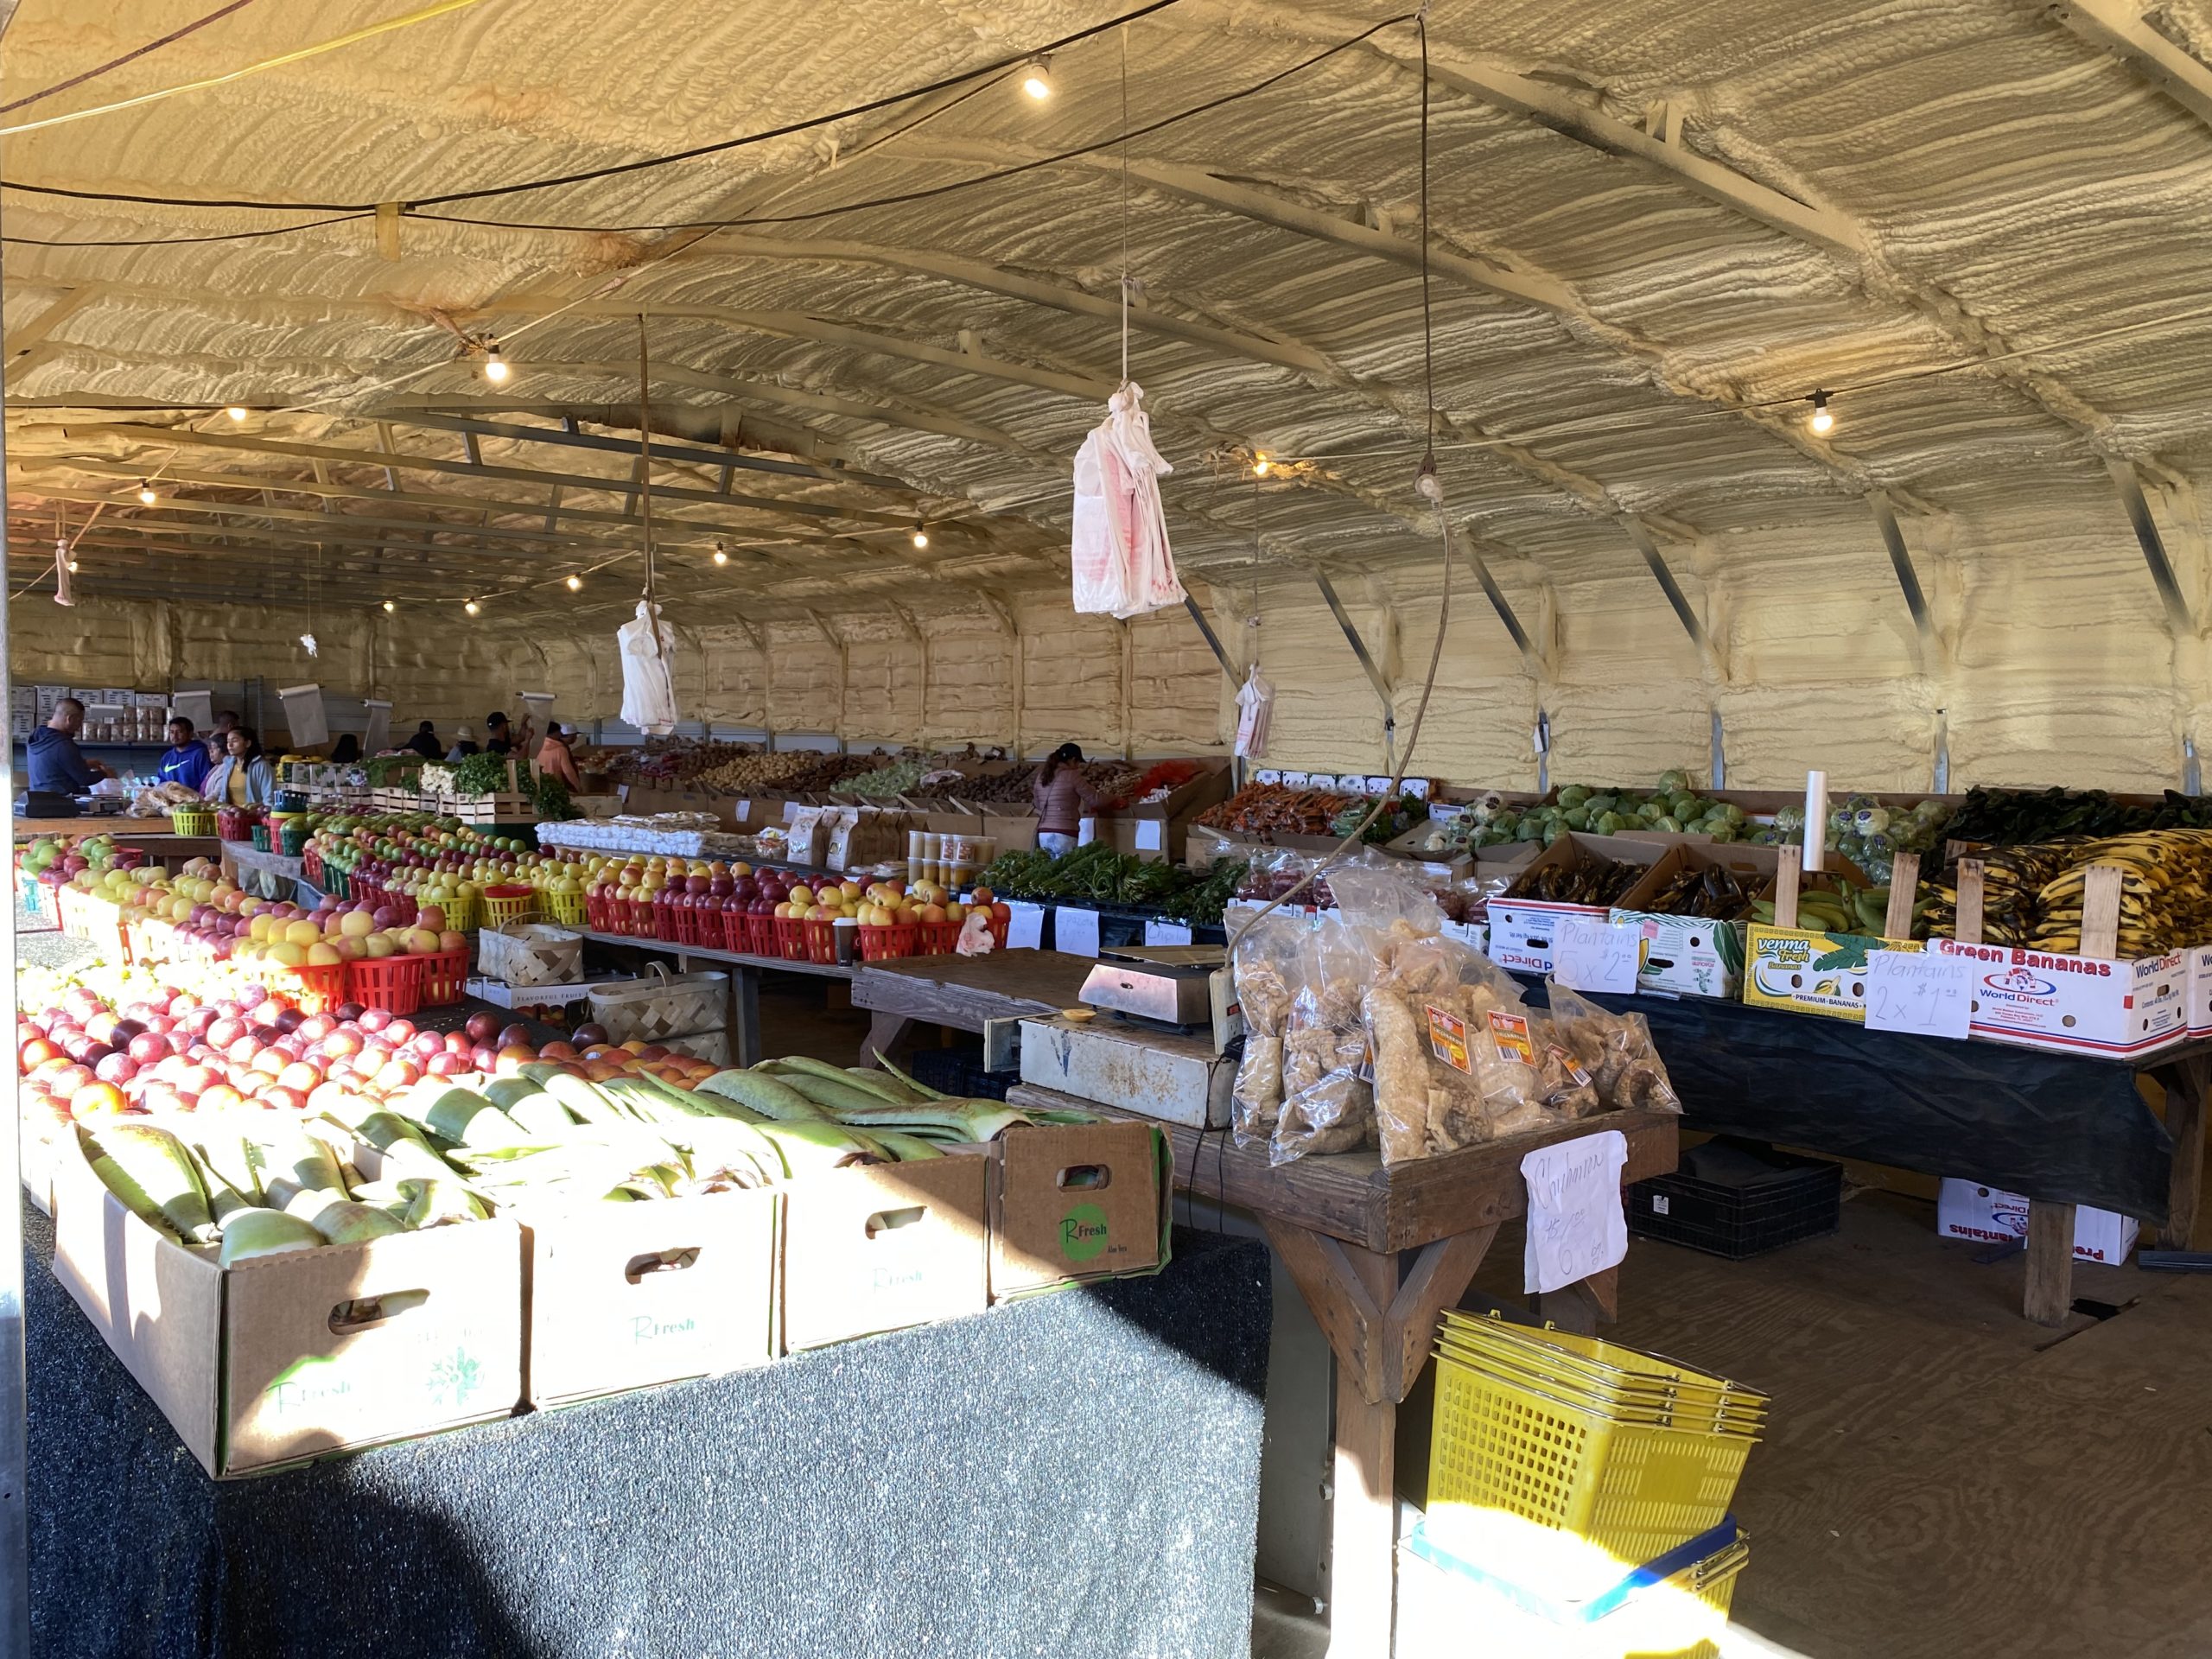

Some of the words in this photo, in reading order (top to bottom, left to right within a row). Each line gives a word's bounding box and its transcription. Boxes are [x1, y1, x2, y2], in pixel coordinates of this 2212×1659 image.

[1560, 923, 1639, 948] Plantains
[1758, 938, 1811, 951] venma
[1502, 953, 1542, 969] Direct
[1777, 949, 1810, 963] Fresh
[1939, 939, 2004, 963] Green
[2012, 948, 2112, 977] Bananas
[1768, 961, 1802, 970] Bananas
[1873, 954, 1966, 979] Plantains
[1795, 994, 1826, 1004] PREMIUM
[1828, 999, 1859, 1009] BANANAS
